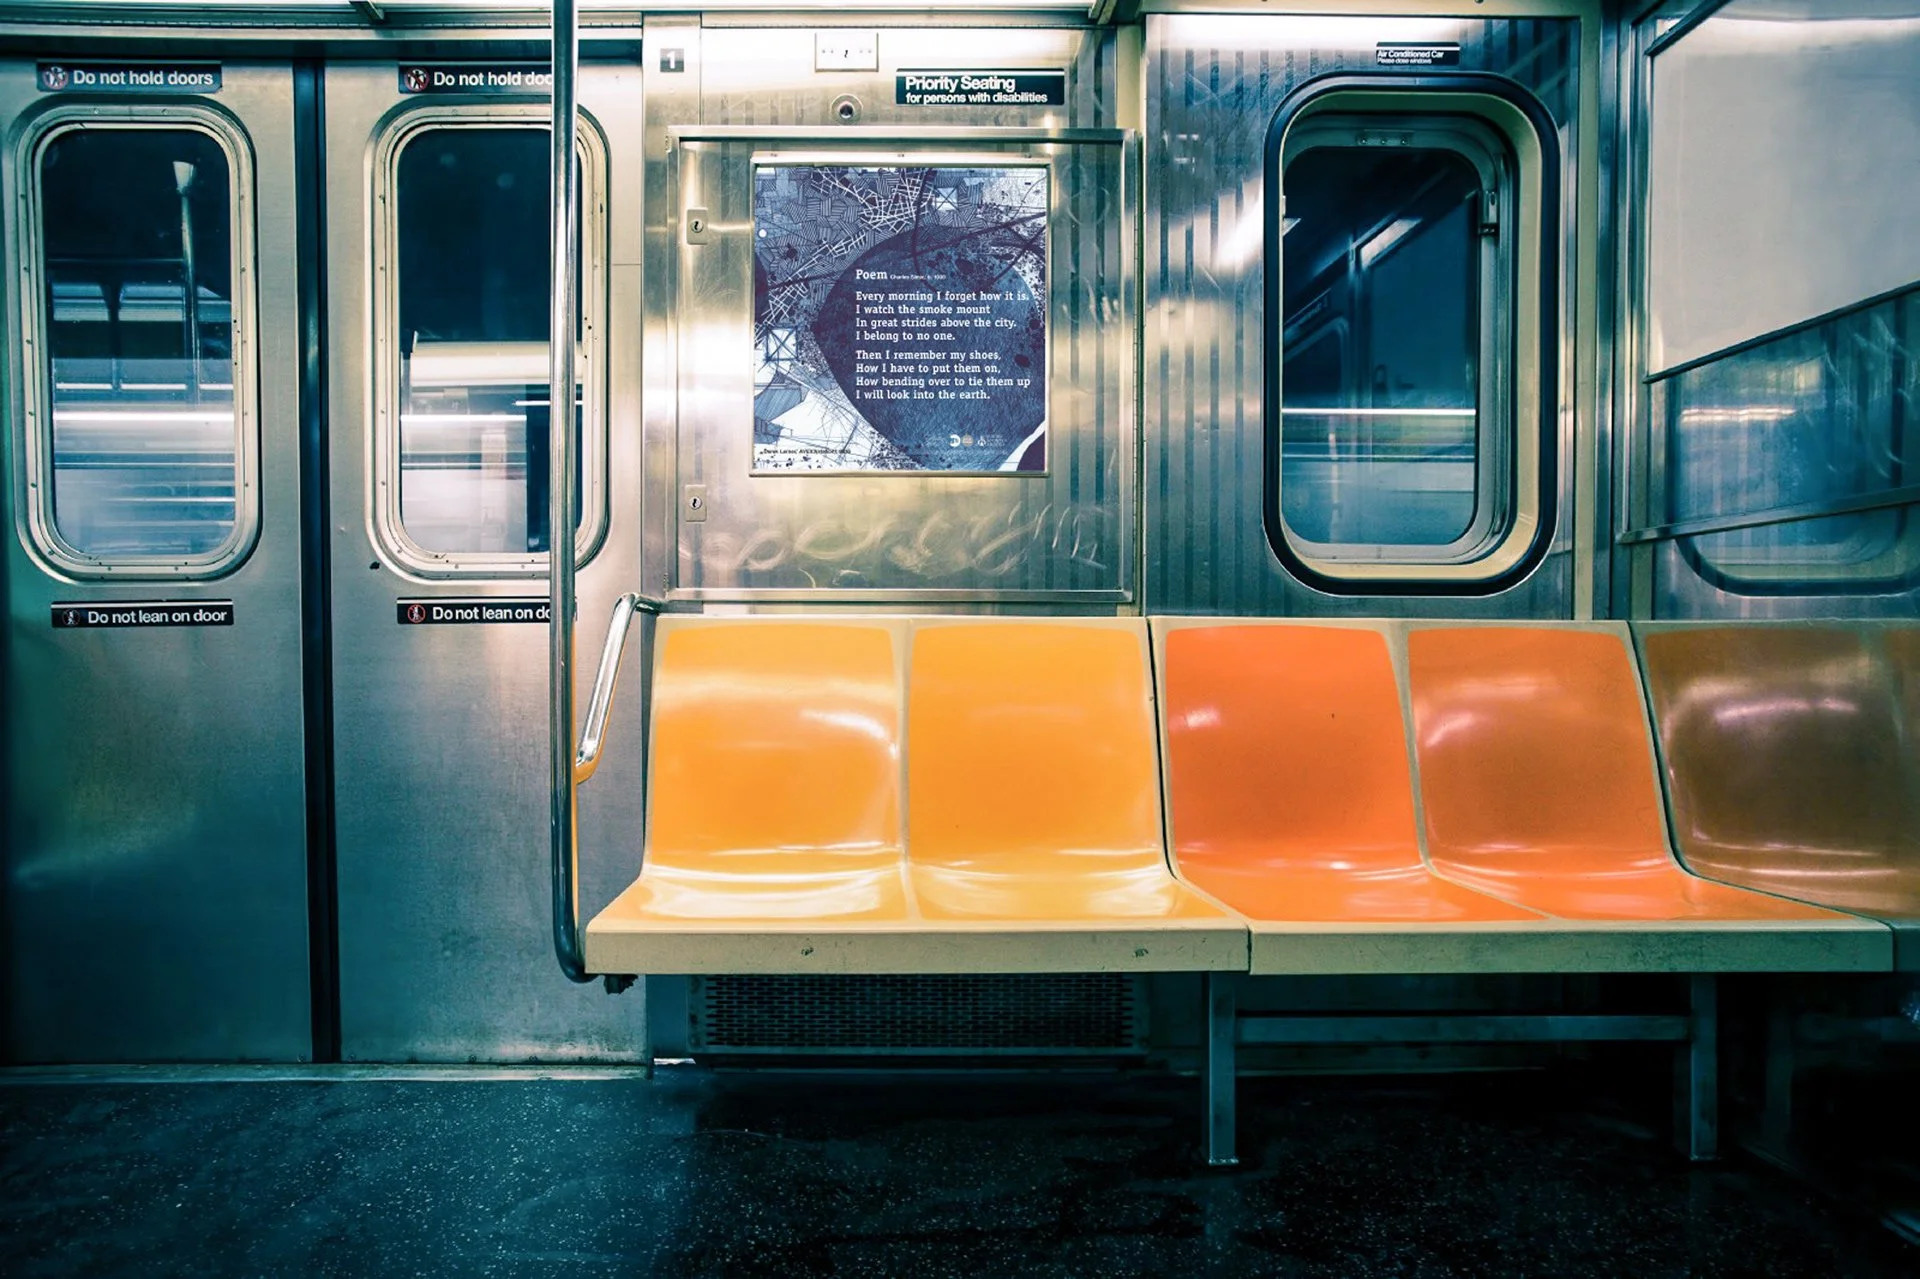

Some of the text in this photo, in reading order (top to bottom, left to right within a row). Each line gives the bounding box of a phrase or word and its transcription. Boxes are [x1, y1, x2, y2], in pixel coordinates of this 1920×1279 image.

[1388, 50, 1430, 58] Conditioned
[1431, 50, 1444, 58] Car
[667, 51, 675, 69] 1
[73, 70, 213, 85] Do not hold doors
[434, 72, 552, 86] Do not hold doo
[905, 75, 1015, 92] Priority Seating
[906, 93, 1047, 104] for persons with disabilities
[856, 269, 887, 280] Poem
[856, 291, 1029, 302] Every morning I forget how it is.
[856, 305, 990, 314] I watch the smoke mount
[856, 318, 1017, 329] In great strides above the city.
[856, 332, 860, 340] I
[864, 331, 898, 342] belong
[856, 350, 1001, 361] Then I remember my shoes,
[856, 364, 1000, 375] How I have to put them on,
[856, 378, 878, 386] How
[882, 377, 925, 388] bending
[955, 378, 964, 386] to
[969, 377, 982, 386] tie
[986, 377, 1013, 386] them
[1017, 379, 1030, 388] up
[856, 390, 990, 399] I will look into the earth.
[88, 609, 227, 623] Do not lean on door
[433, 607, 453, 620] Do
[456, 607, 479, 619] not
[483, 607, 512, 619] lean
[515, 608, 532, 619] on
